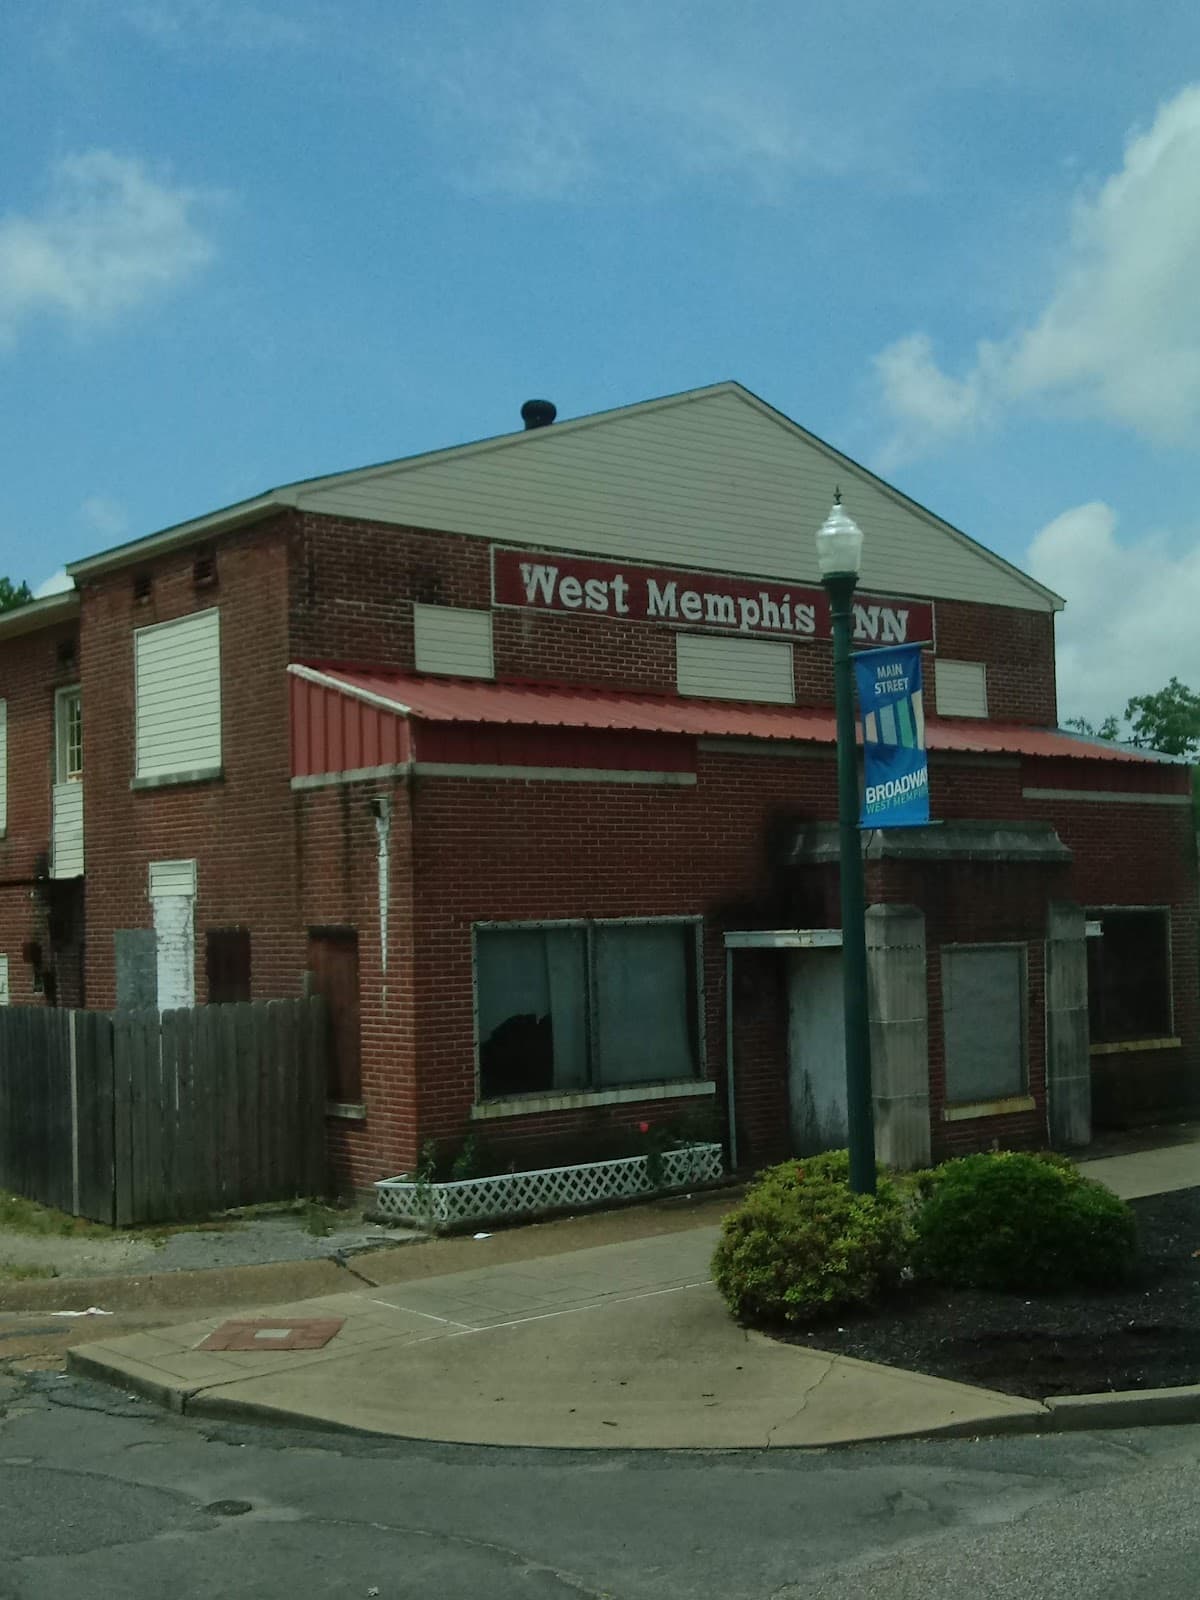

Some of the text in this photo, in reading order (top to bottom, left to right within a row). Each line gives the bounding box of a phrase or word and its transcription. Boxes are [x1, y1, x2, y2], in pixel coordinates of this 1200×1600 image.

[521, 563, 909, 642] West Memphis NN
[877, 664, 903, 678] MAIN
[874, 678, 909, 694] STREET
[866, 799, 890, 815] WEST
